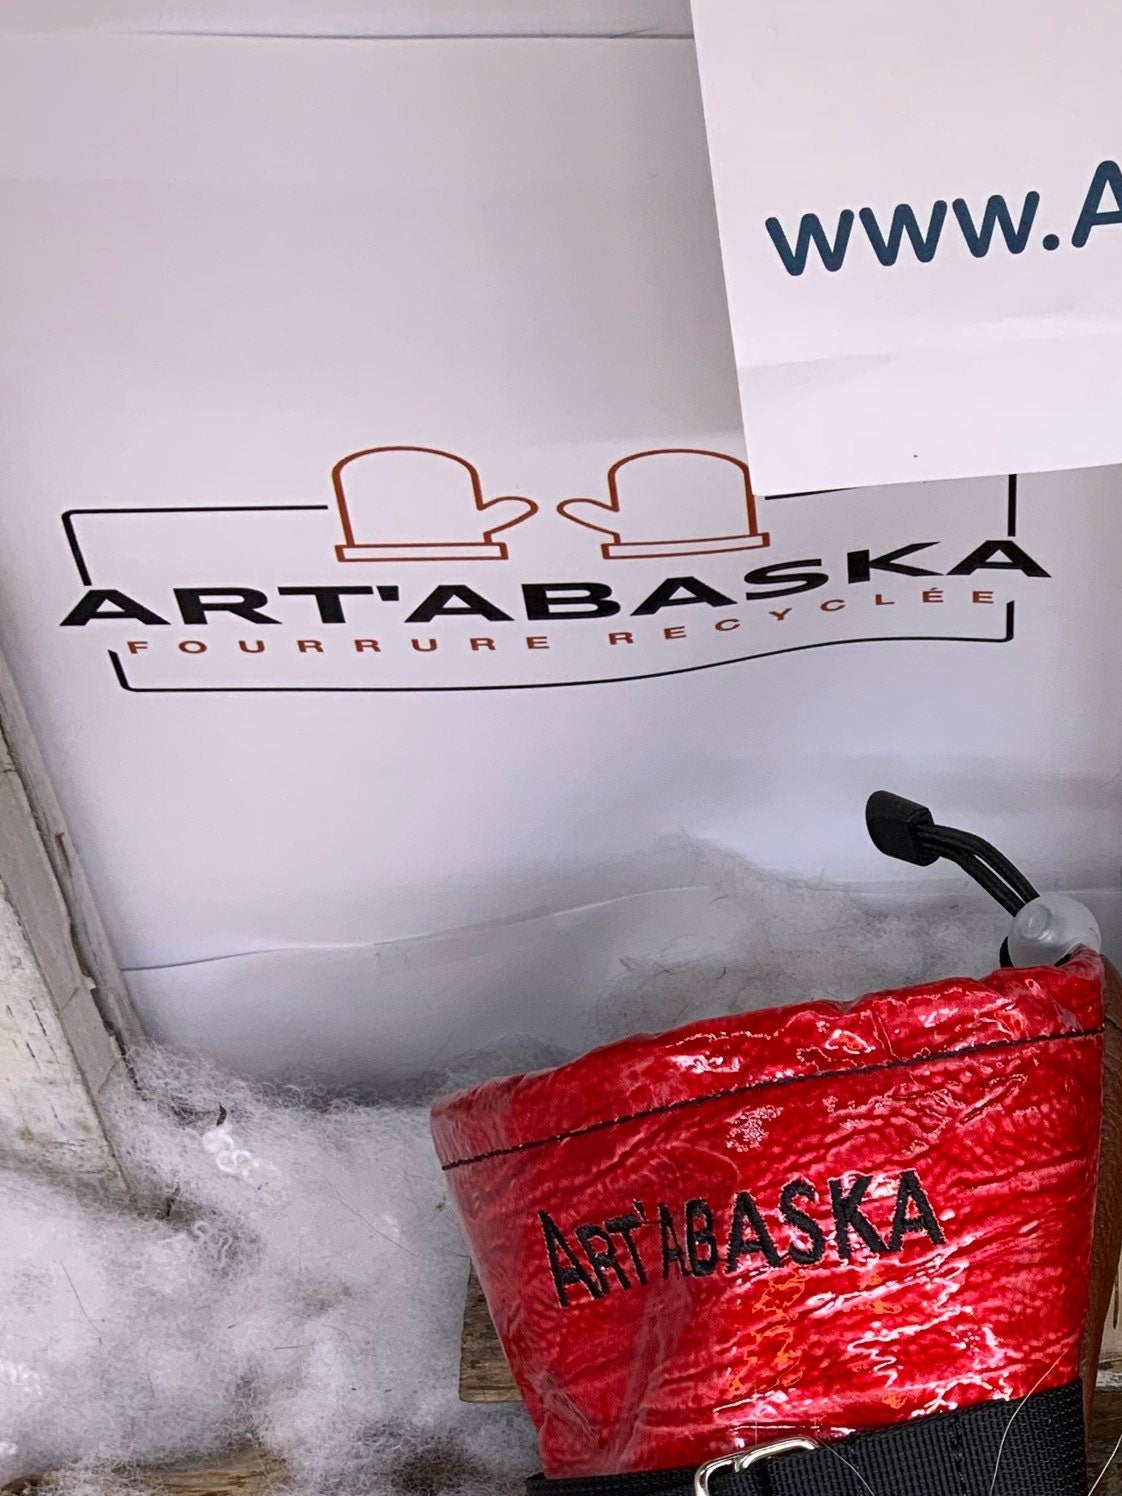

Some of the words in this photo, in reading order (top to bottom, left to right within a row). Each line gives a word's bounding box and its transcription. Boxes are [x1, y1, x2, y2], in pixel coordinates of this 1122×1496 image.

[59, 538, 1051, 627] ART'ABASKA
[127, 634, 550, 655] FOURRURE
[609, 587, 995, 645] RECYCLÉE
